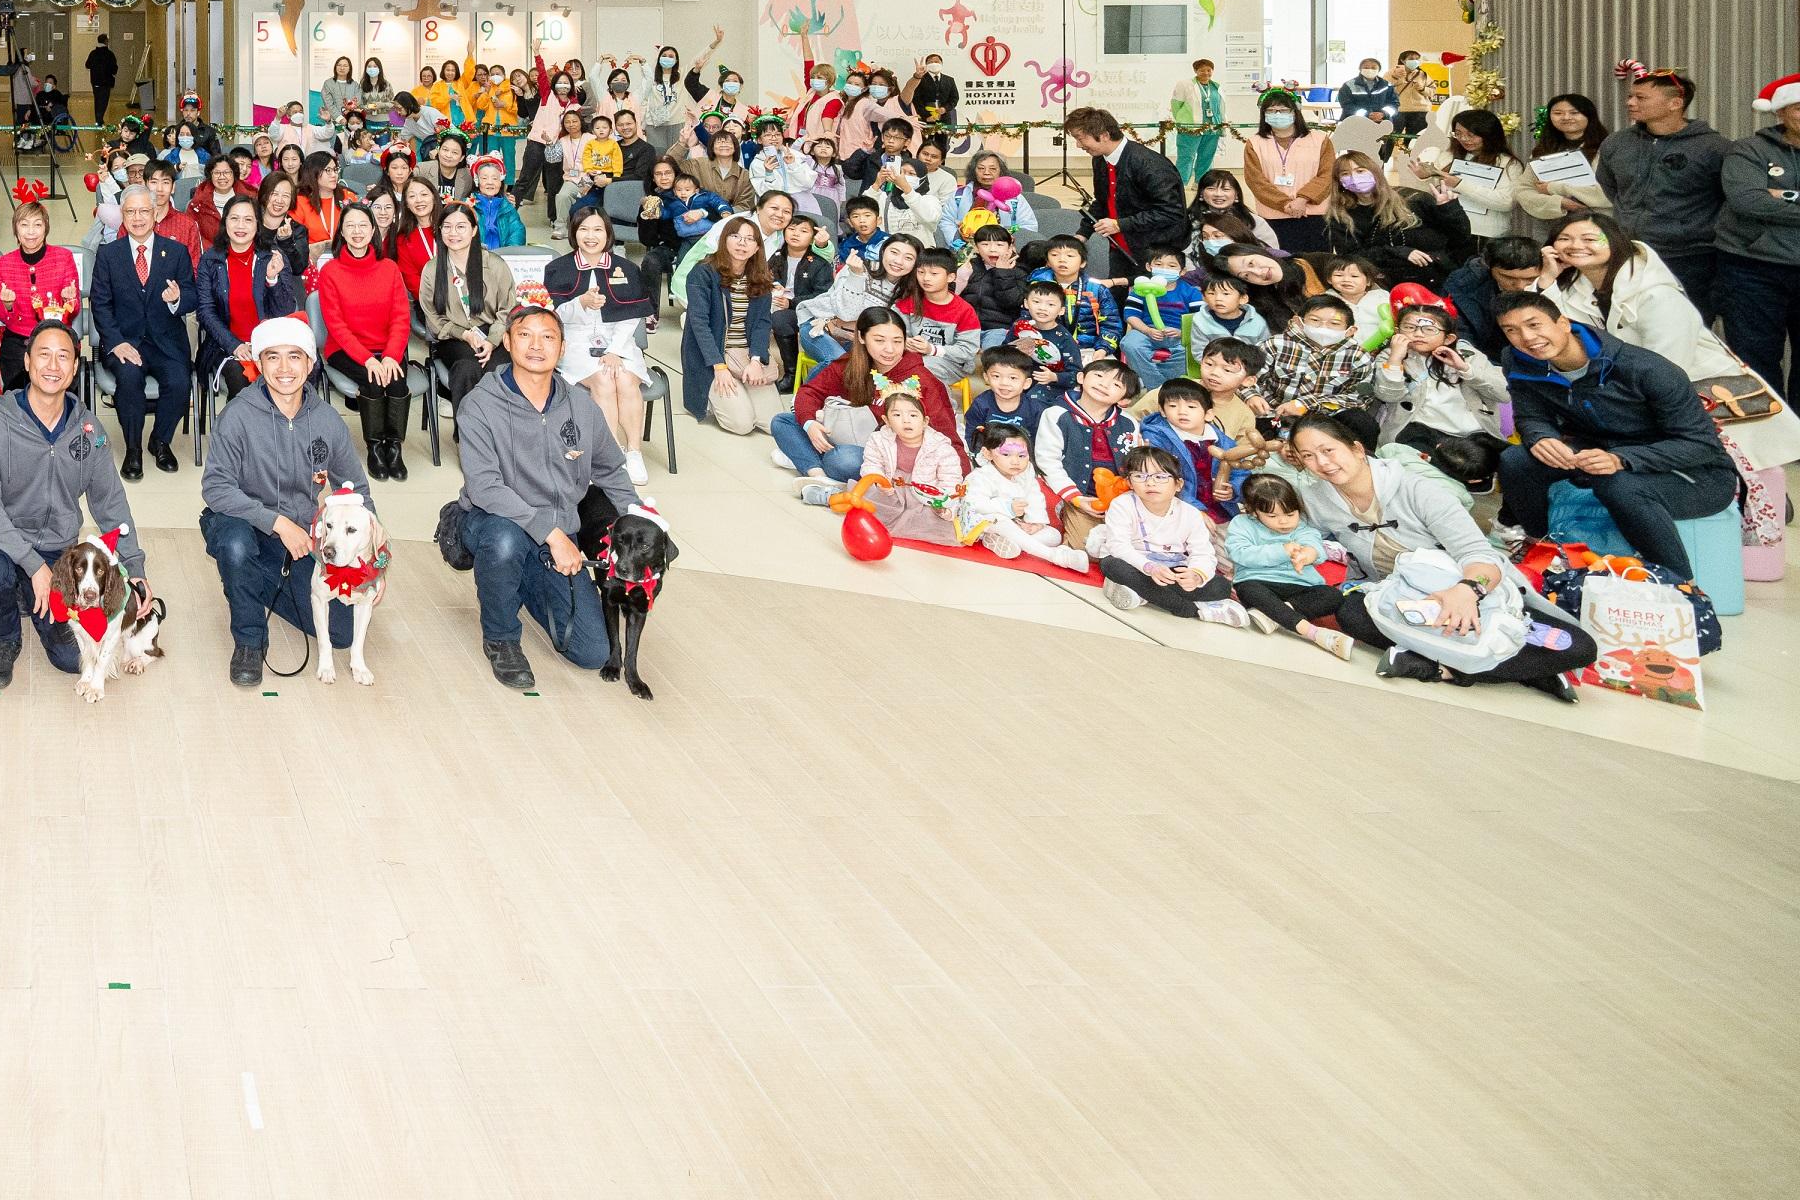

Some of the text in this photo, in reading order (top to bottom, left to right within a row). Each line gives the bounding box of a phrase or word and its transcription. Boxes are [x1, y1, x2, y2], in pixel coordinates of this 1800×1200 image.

[256, 20, 270, 42] 5
[313, 20, 327, 42] 6
[368, 20, 383, 42] 7
[424, 20, 439, 42] 8
[480, 20, 494, 42] 9
[535, 19, 564, 41] 10
[1608, 607, 1665, 622] MERRY
[1608, 615, 1664, 628] CHRISTMAS
